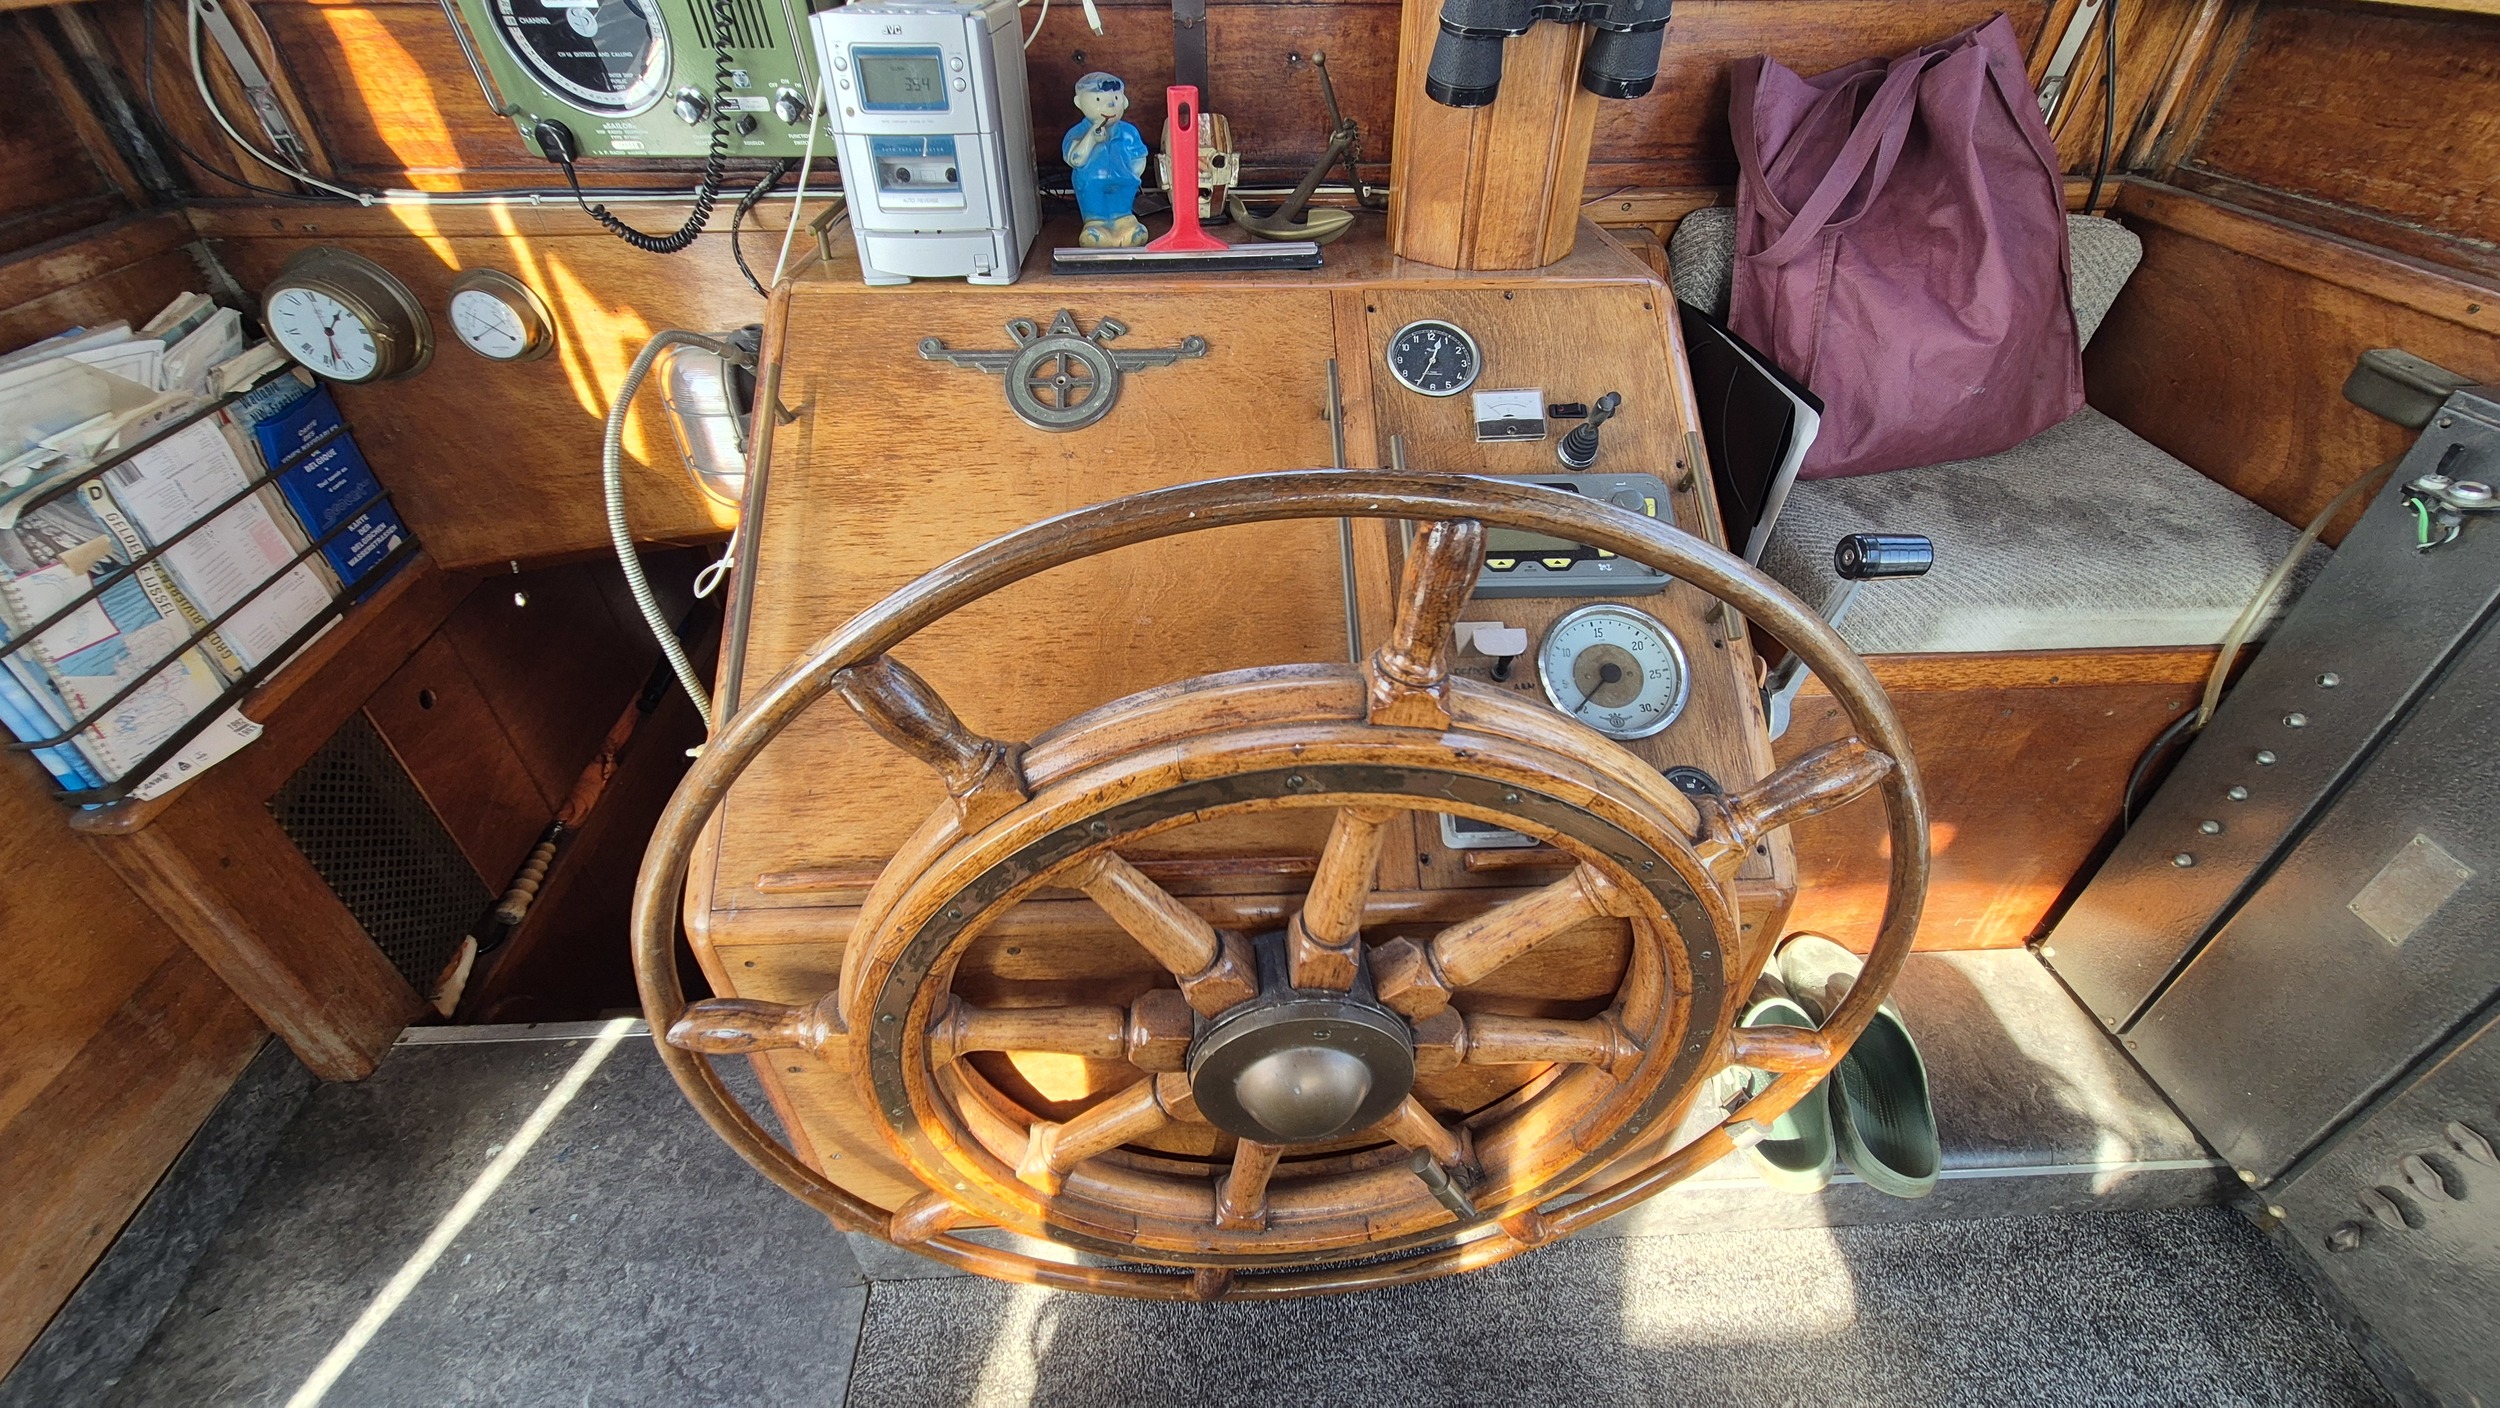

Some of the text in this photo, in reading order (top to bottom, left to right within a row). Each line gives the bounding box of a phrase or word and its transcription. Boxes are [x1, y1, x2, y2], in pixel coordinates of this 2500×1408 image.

[519, 16, 551, 25] CHANNEL
[881, 25, 902, 35] JVC
[1413, 335, 1419, 344] 11
[1427, 332, 1436, 341] 12
[1444, 336, 1449, 345] 1
[1401, 343, 1410, 352] 10
[1455, 346, 1462, 355] 2
[1397, 356, 1403, 364] 9
[1460, 359, 1468, 368] 3
[1402, 369, 1408, 378] 8
[1456, 372, 1463, 380] 4
[1429, 383, 1436, 391] 6
[1445, 381, 1452, 389] 5
[240, 382, 281, 409] Wallonie
[304, 448, 338, 473] BELGIQUE
[87, 486, 103, 501] D
[347, 513, 370, 532] KARTE
[357, 523, 372, 536] DER
[350, 521, 387, 553] BELGISCHEN
[347, 524, 398, 567] WASSERSTRASSEN
[144, 574, 176, 618] IJSSEL
[1594, 627, 1604, 639] 15
[1631, 640, 1644, 652] 20
[1561, 648, 1571, 658] 10
[1649, 669, 1662, 680] 25
[1638, 703, 1652, 713] 30
